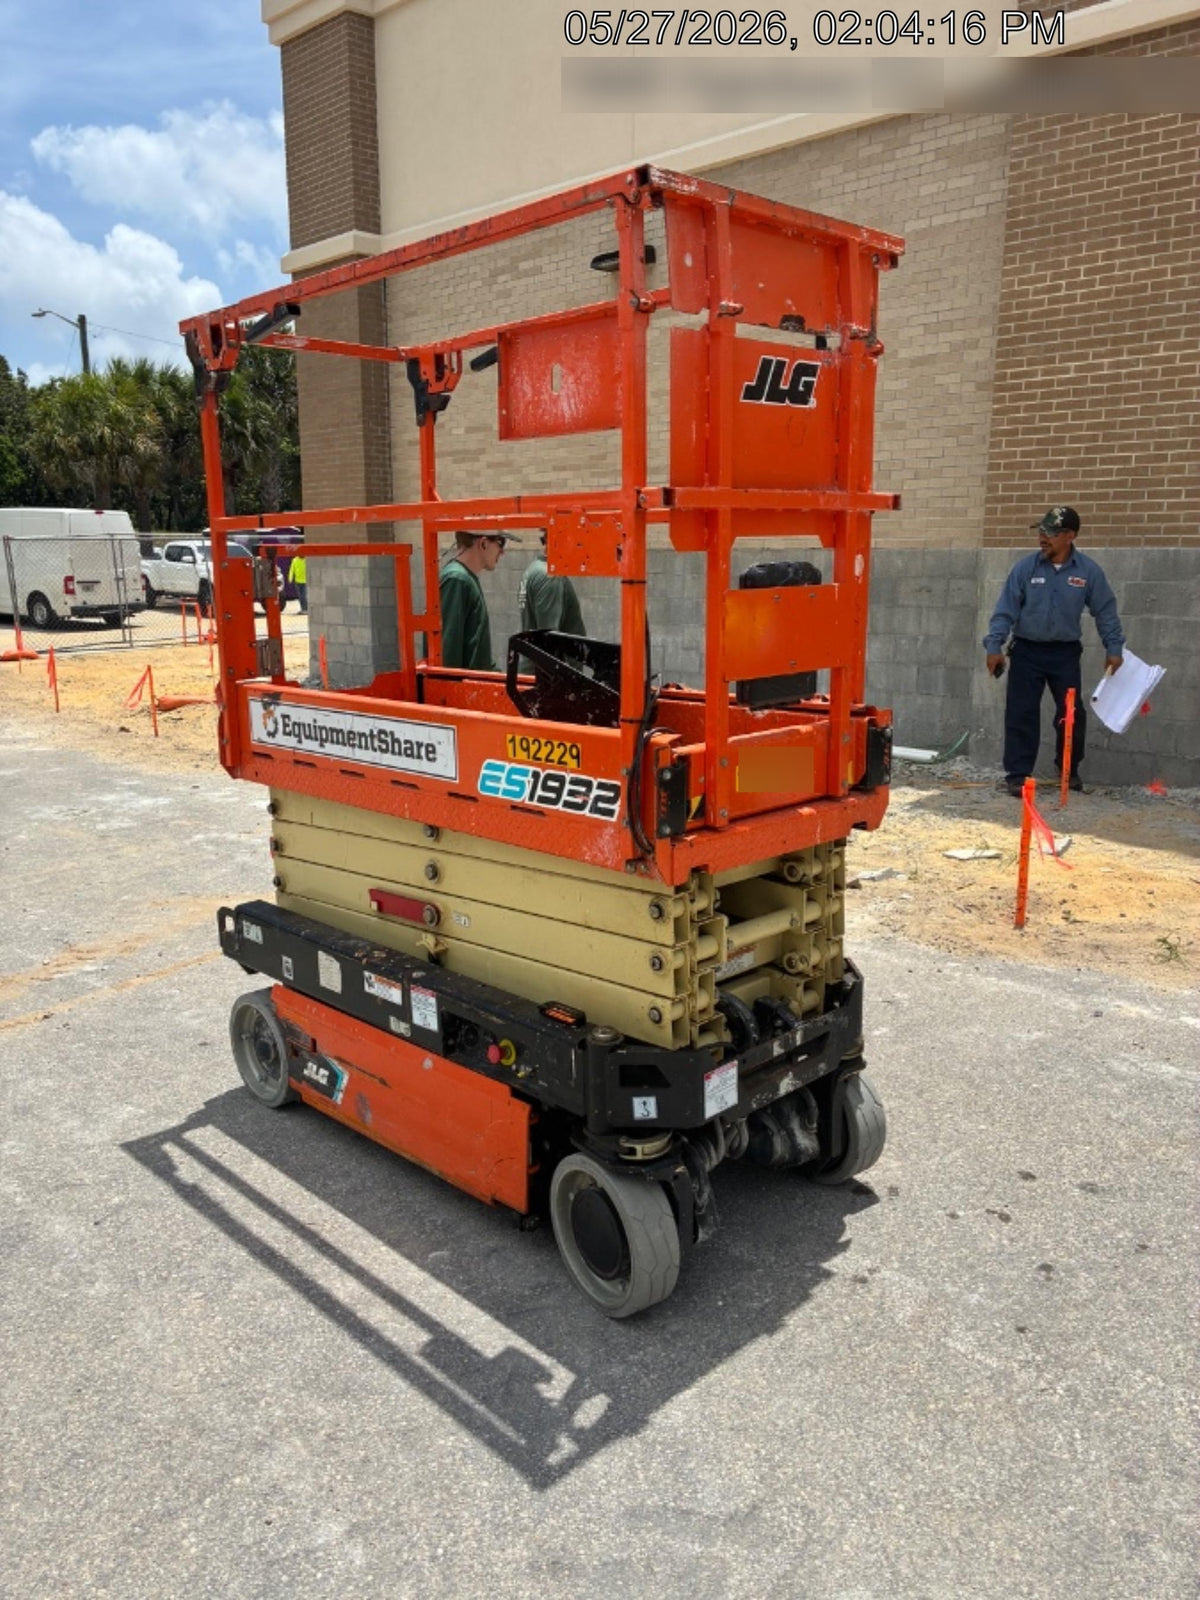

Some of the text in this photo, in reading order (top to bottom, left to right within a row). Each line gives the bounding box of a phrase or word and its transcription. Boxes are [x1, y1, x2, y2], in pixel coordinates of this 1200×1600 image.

[741, 355, 820, 407] JLG
[281, 713, 437, 763] EquipmentShare
[508, 735, 581, 768] 192229
[479, 760, 621, 820] ES1932
[303, 1061, 329, 1087] JLG
